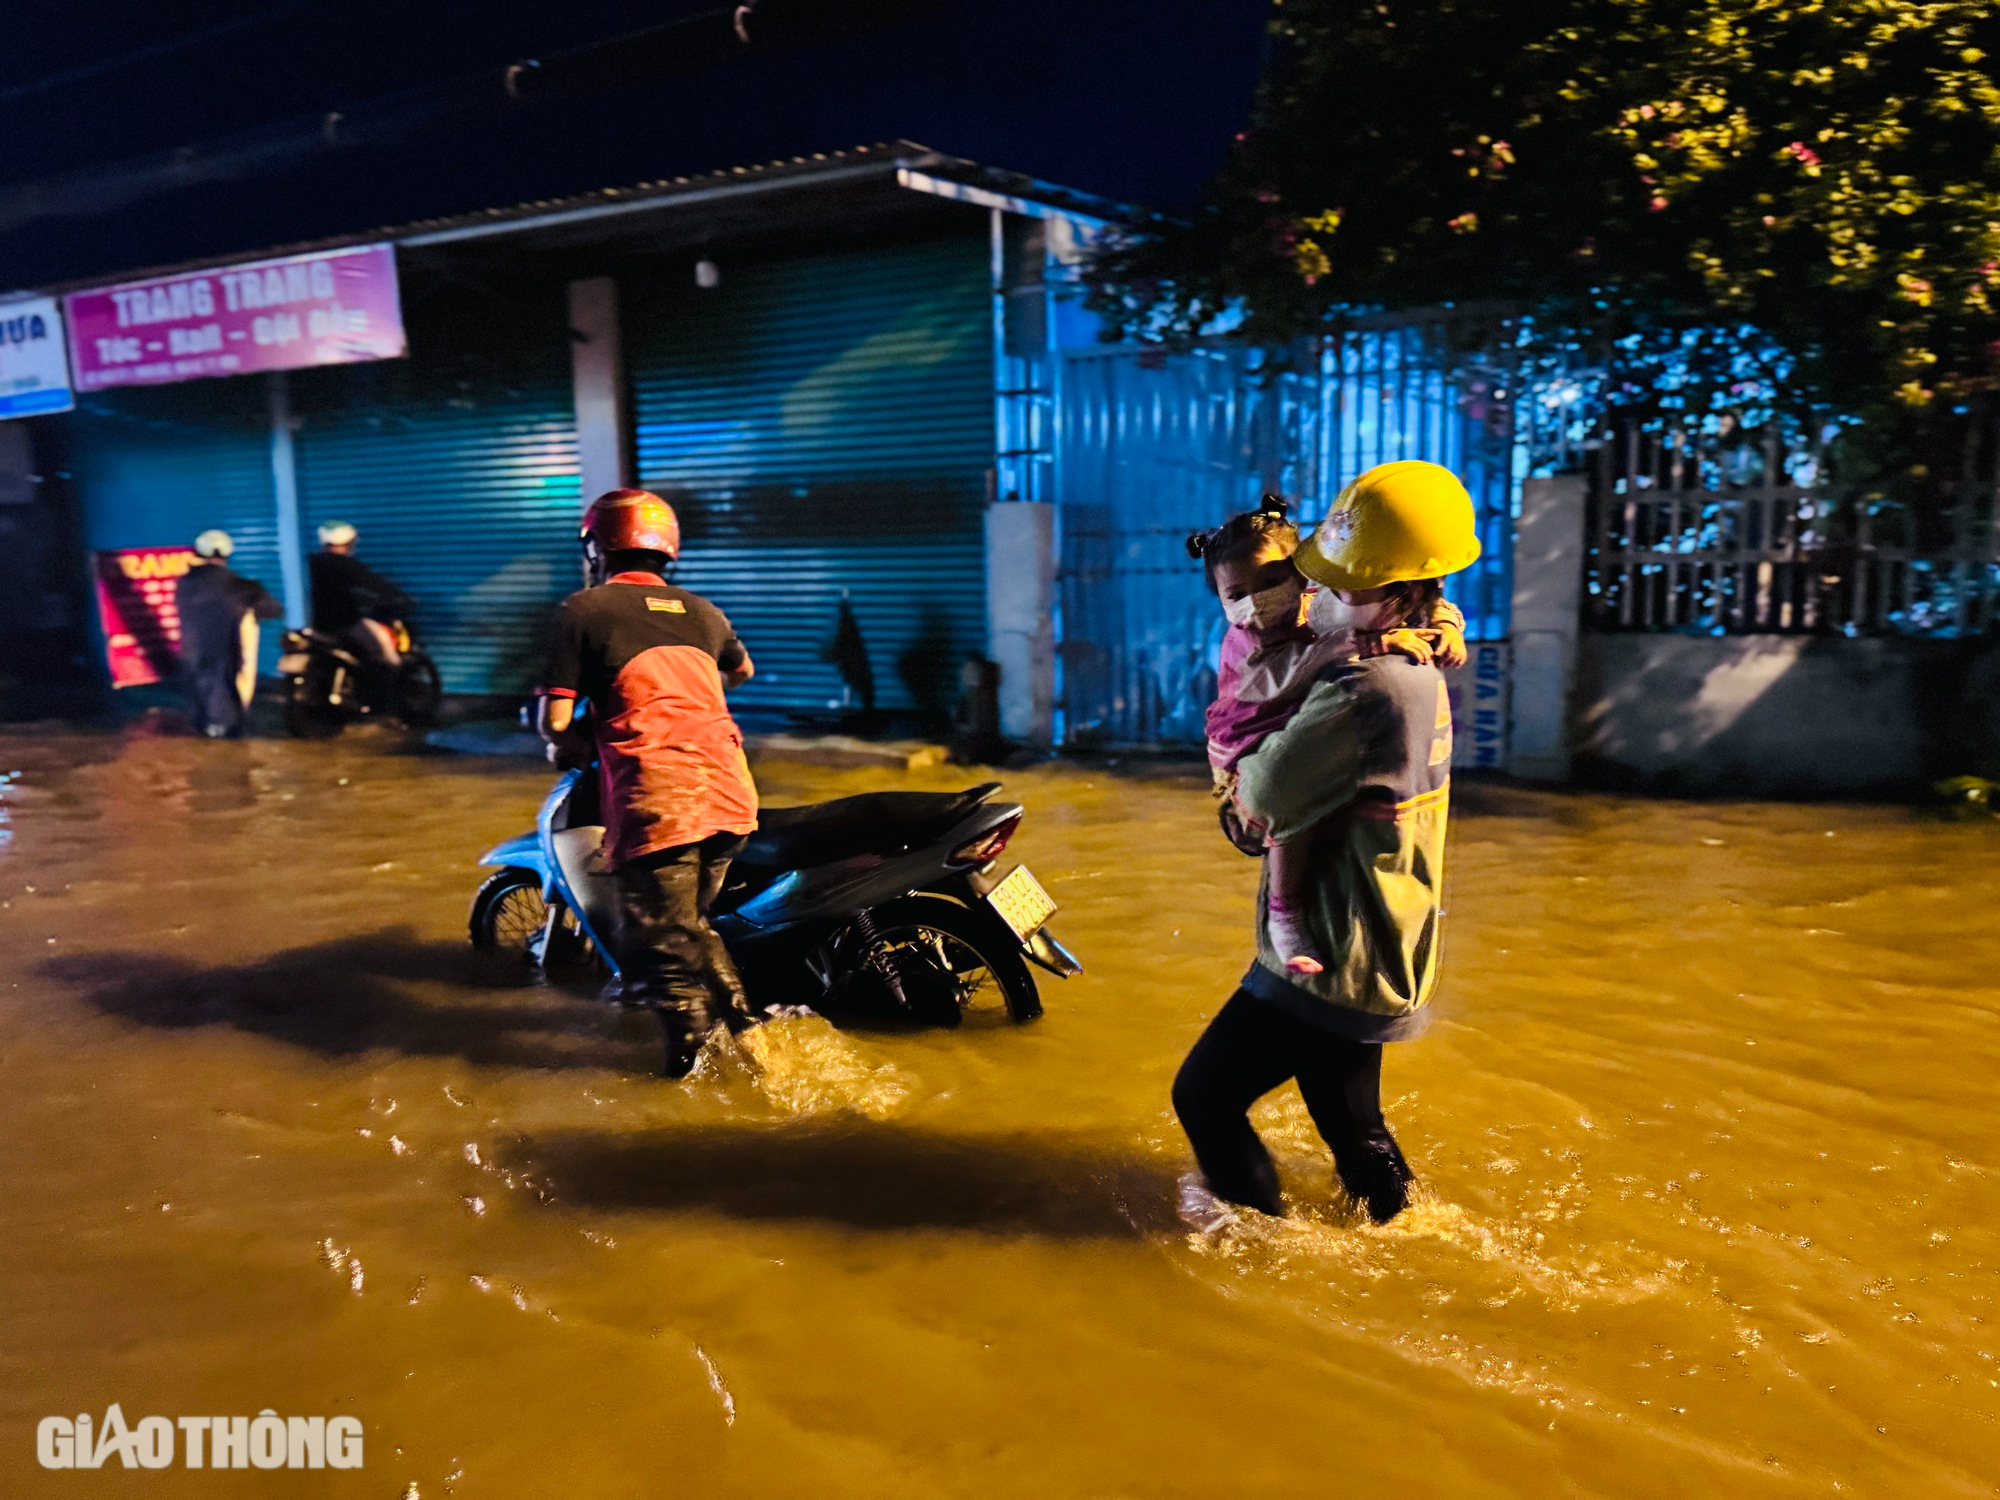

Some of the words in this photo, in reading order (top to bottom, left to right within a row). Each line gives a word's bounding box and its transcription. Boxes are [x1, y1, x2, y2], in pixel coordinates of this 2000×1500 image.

[112, 279, 214, 327] TRANG
[221, 260, 334, 311] TRANG
[0, 314, 46, 351] ỰA
